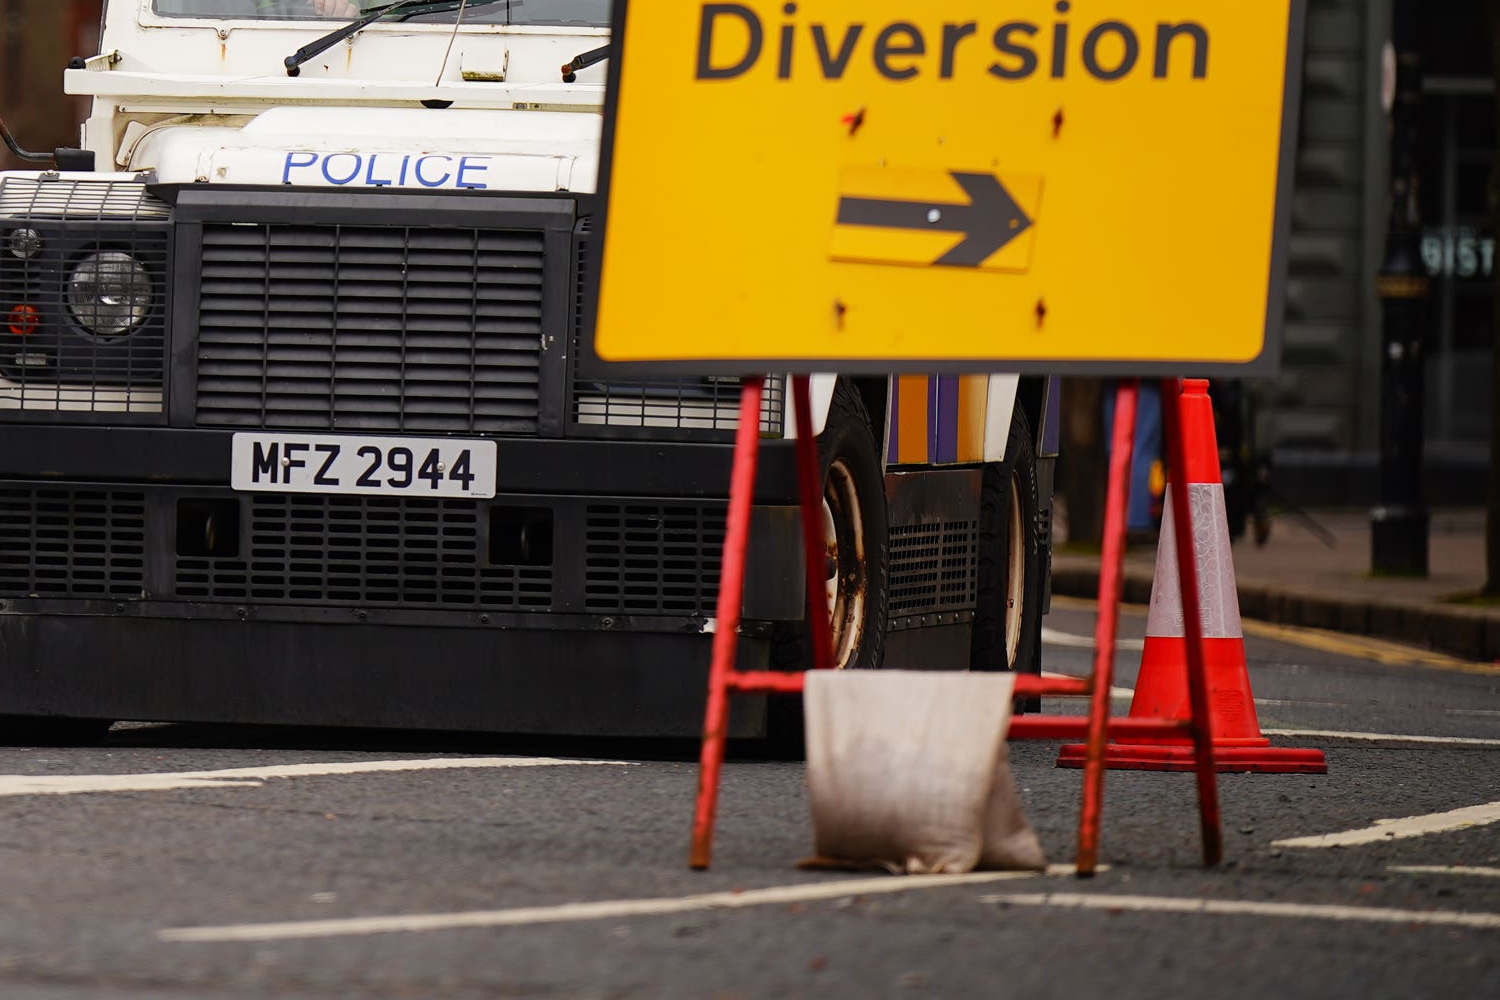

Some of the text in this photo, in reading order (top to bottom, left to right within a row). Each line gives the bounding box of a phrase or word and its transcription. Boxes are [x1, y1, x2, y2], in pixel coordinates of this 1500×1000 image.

[281, 151, 493, 190] POLICE
[251, 441, 475, 491] MFZ 2944
